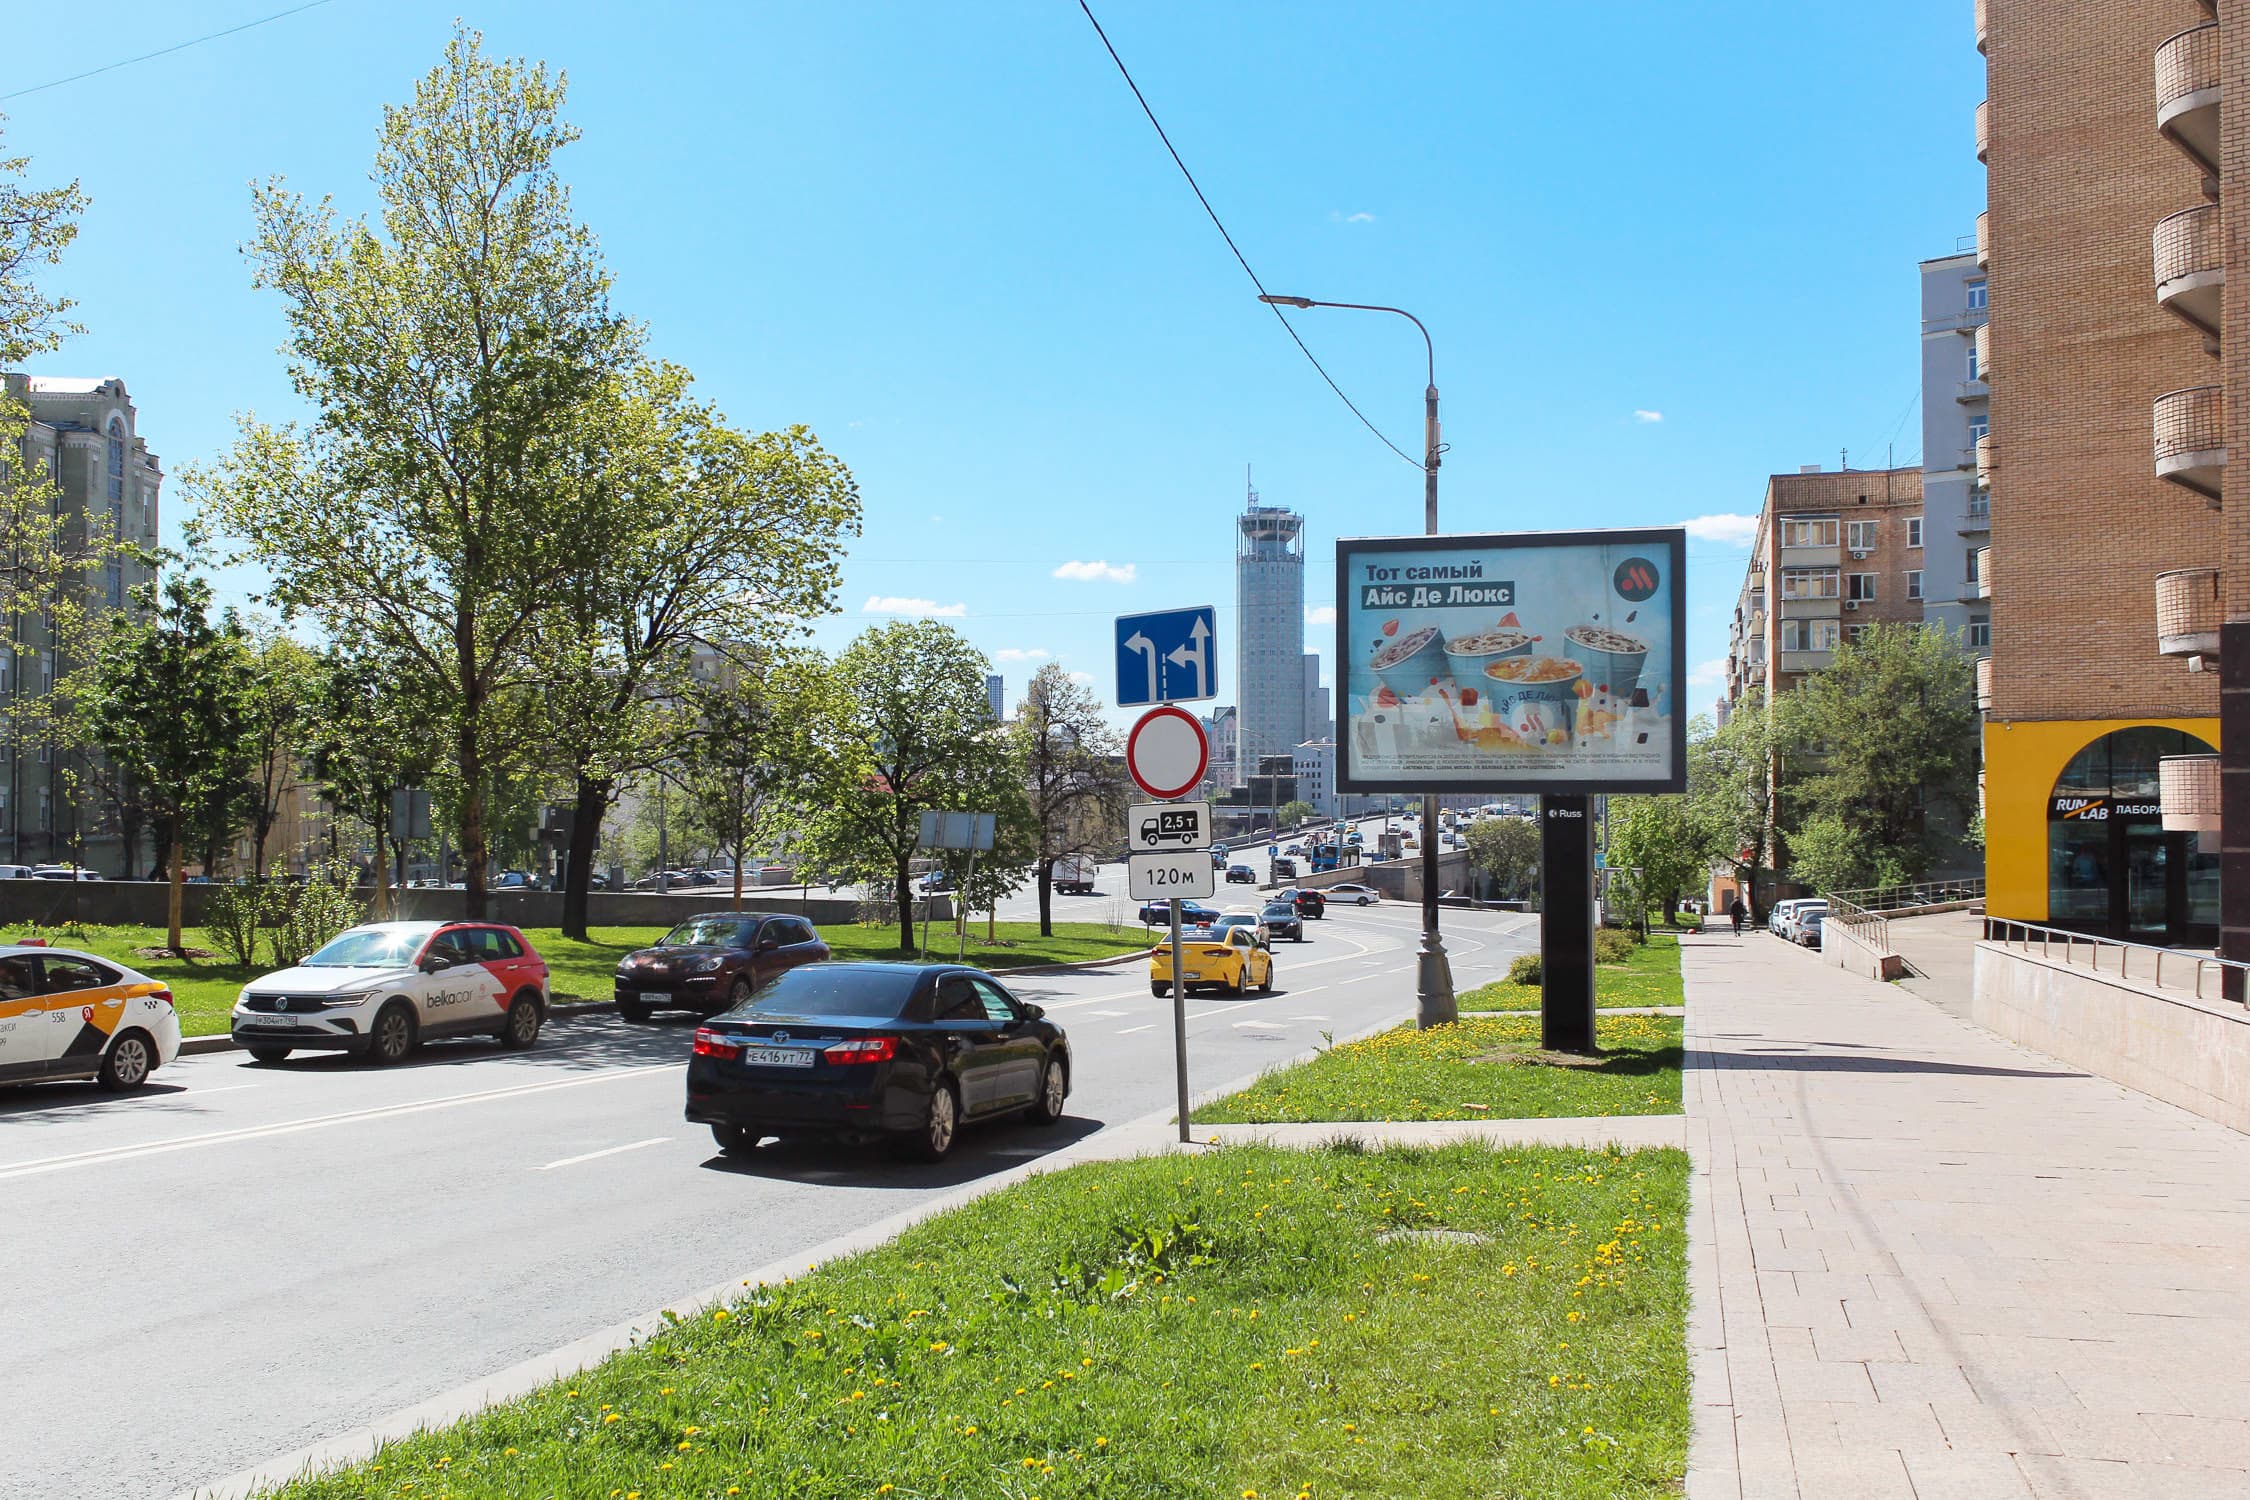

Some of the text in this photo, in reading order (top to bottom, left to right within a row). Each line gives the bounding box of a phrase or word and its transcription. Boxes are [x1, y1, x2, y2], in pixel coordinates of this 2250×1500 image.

[1366, 560, 1482, 581] Тот самый
[1365, 586, 1510, 608] Айс Де Люкс
[1518, 690, 1533, 701] ДЕ
[2056, 799, 2087, 811] RUN
[1559, 809, 1582, 818] Russ
[2080, 808, 2109, 820] LAB
[1165, 816, 1183, 829] 2,5
[426, 990, 474, 1008] belkacar
[52, 1012, 66, 1023] 558
